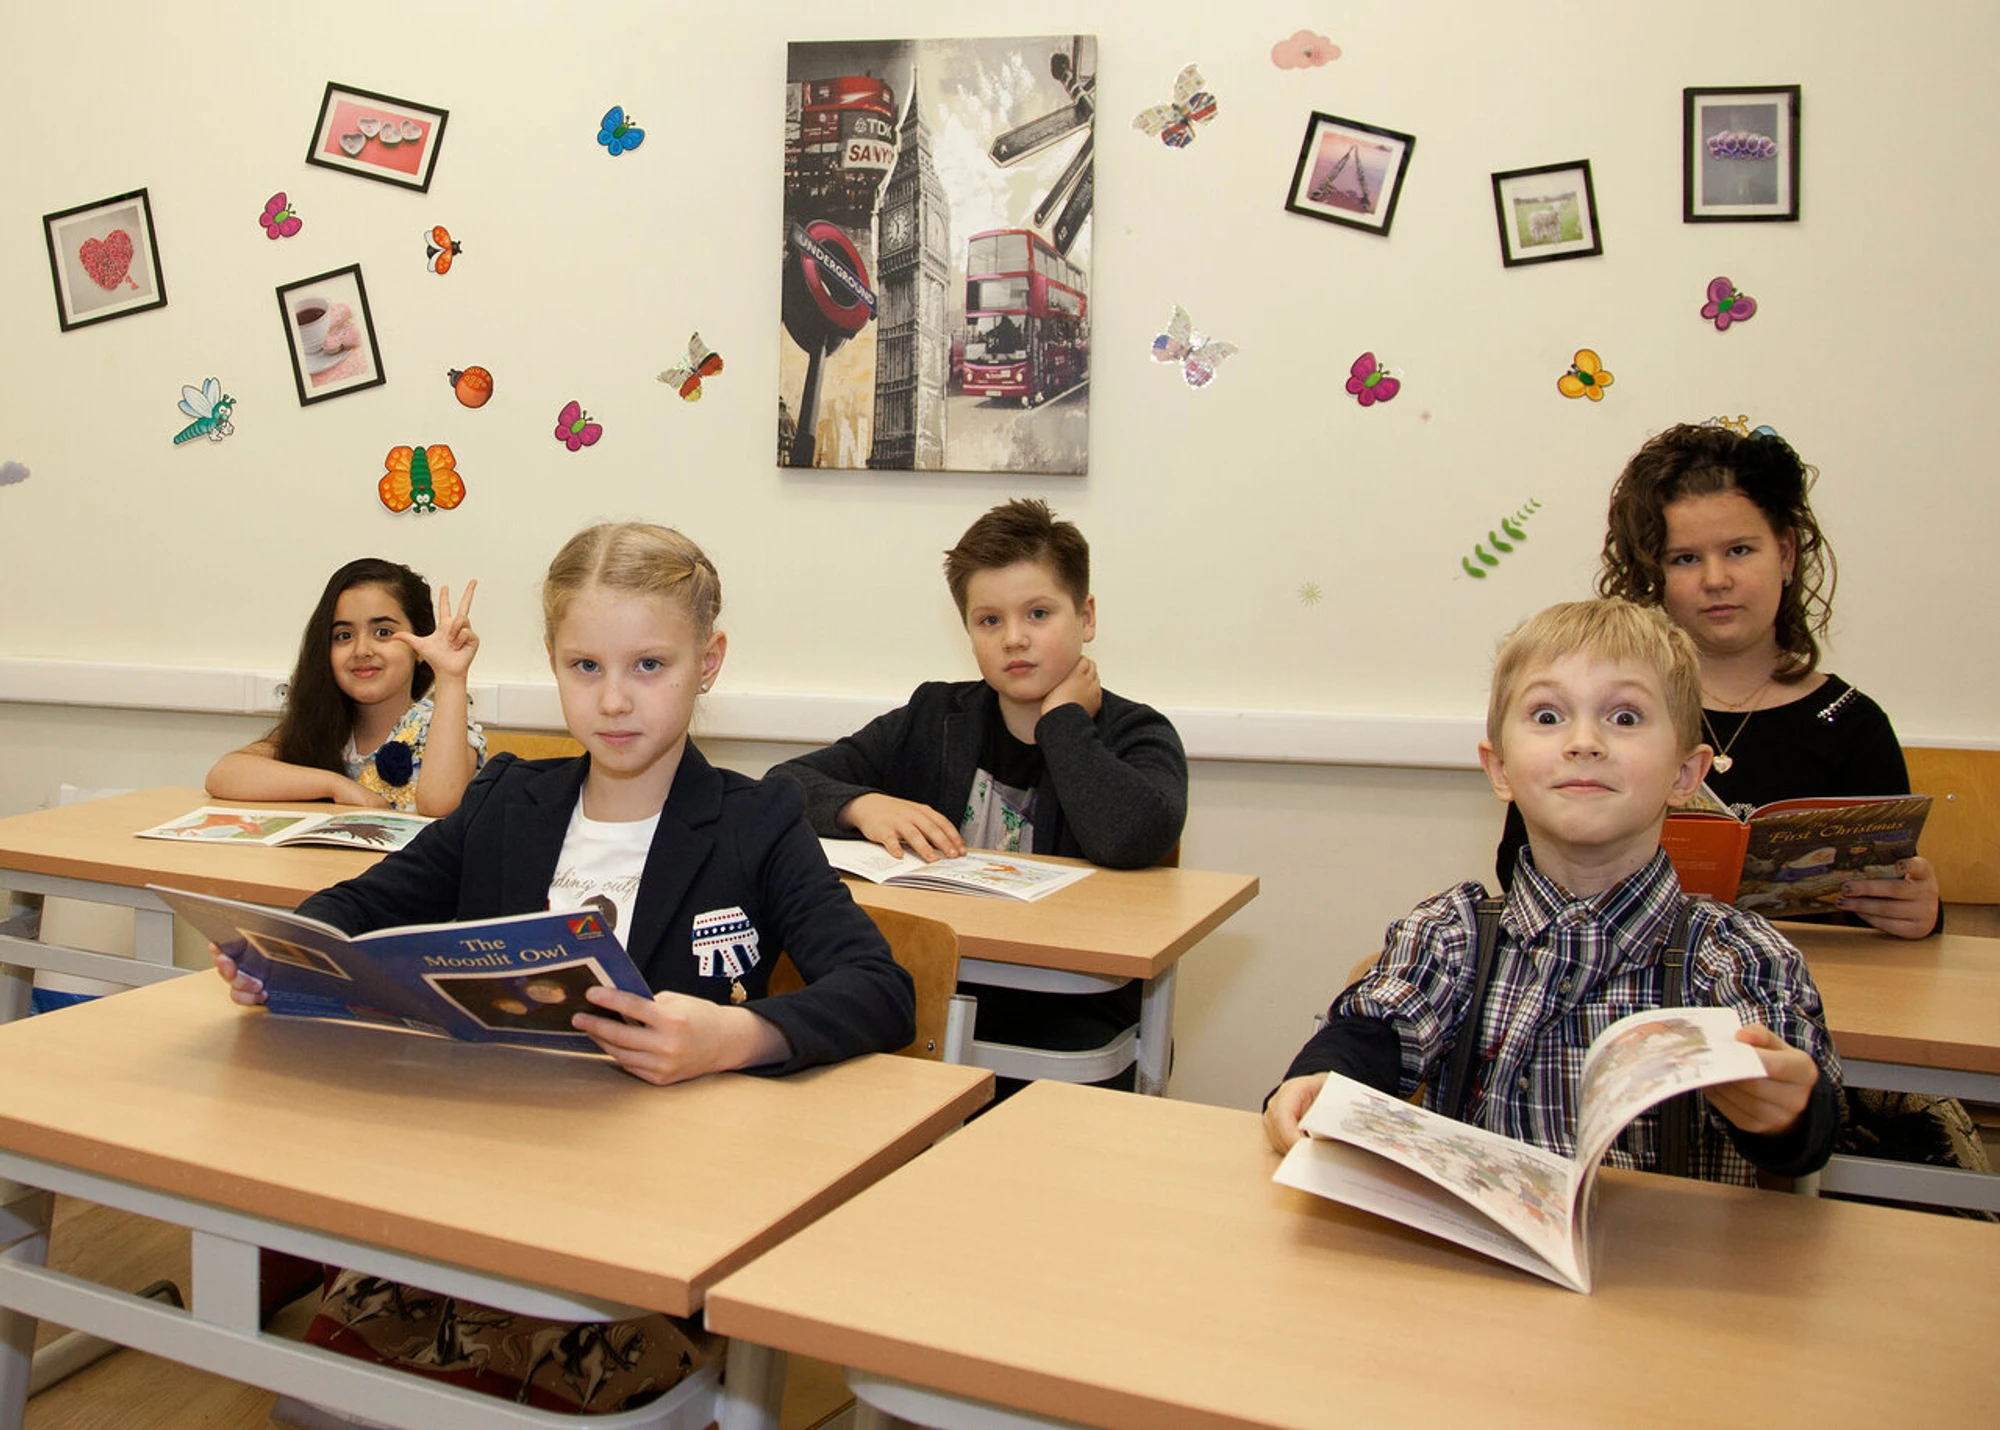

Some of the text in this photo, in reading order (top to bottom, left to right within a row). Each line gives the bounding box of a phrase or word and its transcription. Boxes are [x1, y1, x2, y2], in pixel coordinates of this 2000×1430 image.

[866, 118, 892, 138] TDK
[799, 233, 875, 305] UNDERGROUND
[1768, 821, 1906, 843] First Christmas
[422, 944, 568, 968] Moonlit Owl
[459, 938, 506, 953] The
